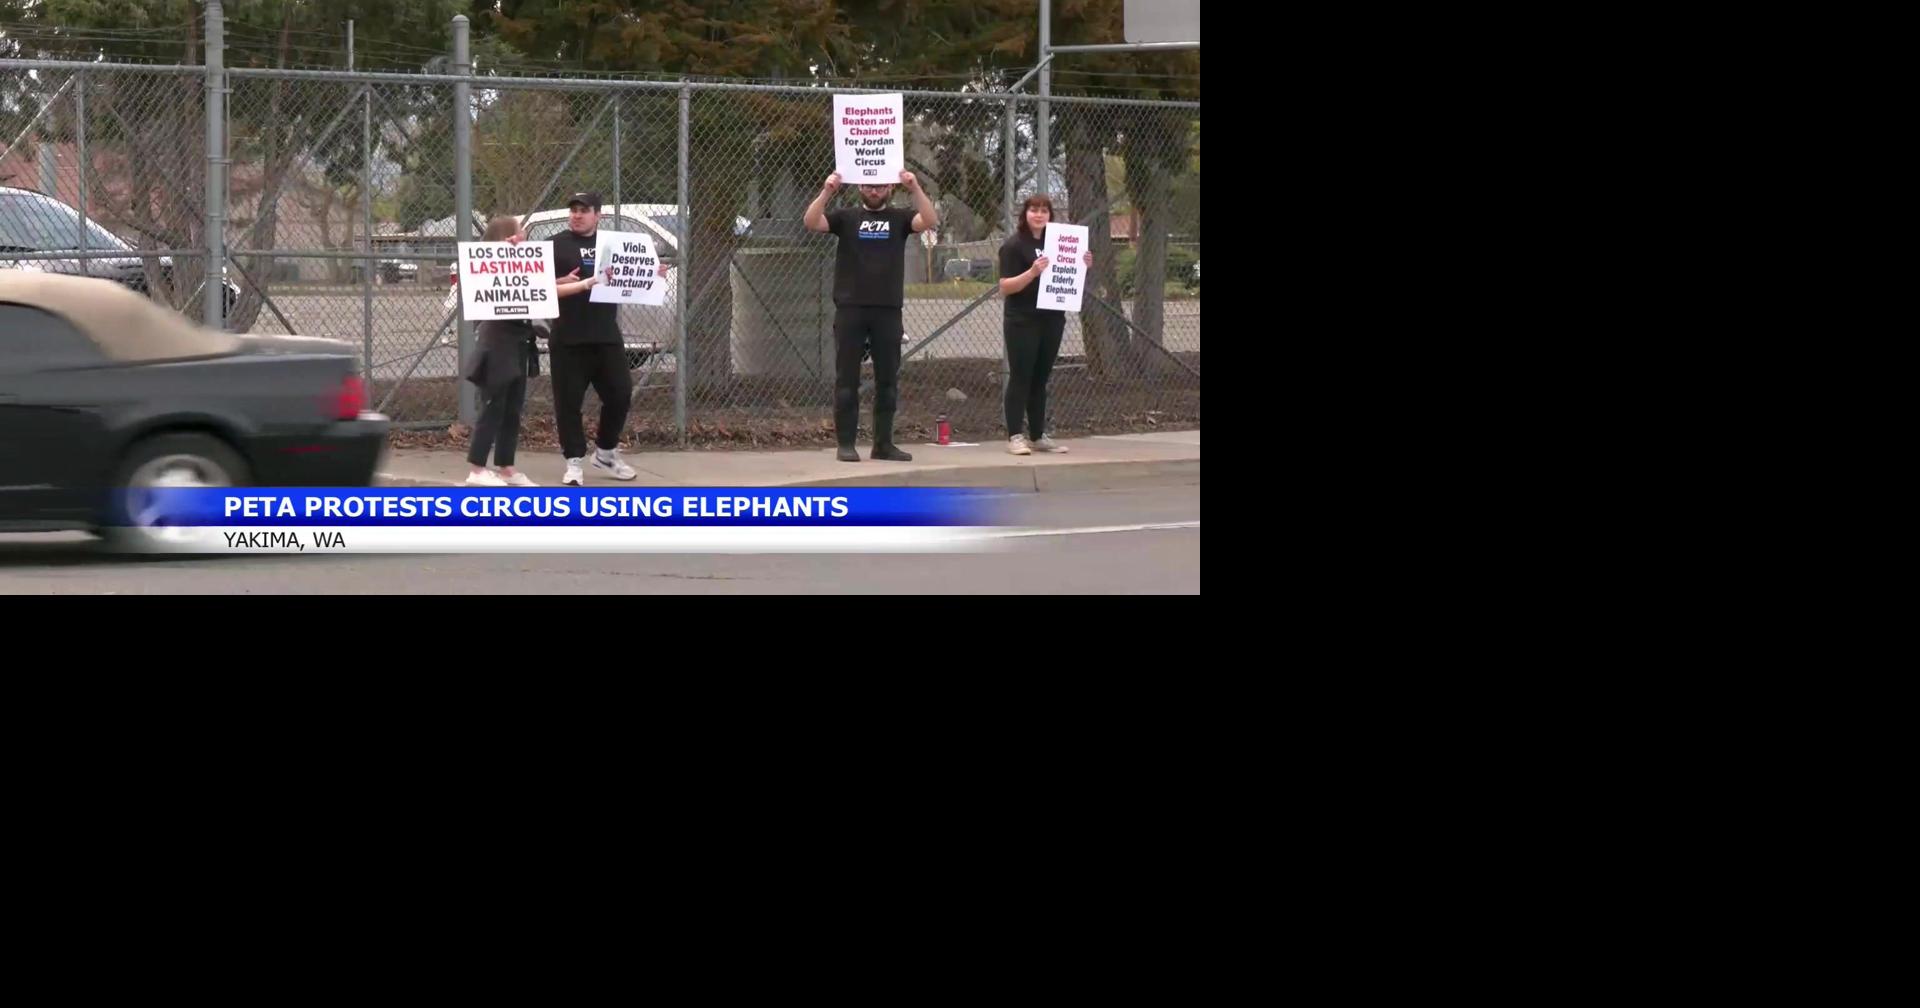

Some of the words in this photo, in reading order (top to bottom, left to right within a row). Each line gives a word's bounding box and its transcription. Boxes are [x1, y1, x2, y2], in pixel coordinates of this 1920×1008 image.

[845, 107, 893, 116] Elephants
[842, 117, 876, 126] Beaten
[879, 116, 896, 125] and
[850, 127, 889, 135] Chained
[845, 137, 859, 146] for
[861, 137, 894, 146] Jordan
[855, 147, 885, 156] World
[855, 157, 886, 166] Circus
[1058, 234, 1079, 244] Jordan
[623, 242, 646, 253] Viola
[1058, 244, 1077, 254] World
[469, 248, 493, 259] LOS
[497, 247, 543, 258] CIRCOS
[612, 254, 655, 266] Deserves
[1056, 254, 1076, 264] Circus
[470, 261, 545, 274] LASTIMAN
[622, 266, 635, 276] Be
[636, 266, 646, 277] in
[647, 269, 654, 278] a
[1052, 264, 1077, 275] Exploits
[493, 277, 502, 287] A
[505, 276, 530, 286] LOS
[1052, 275, 1074, 285] Elderly
[1046, 284, 1077, 295] Elephants
[474, 289, 547, 302] ANIMALES
